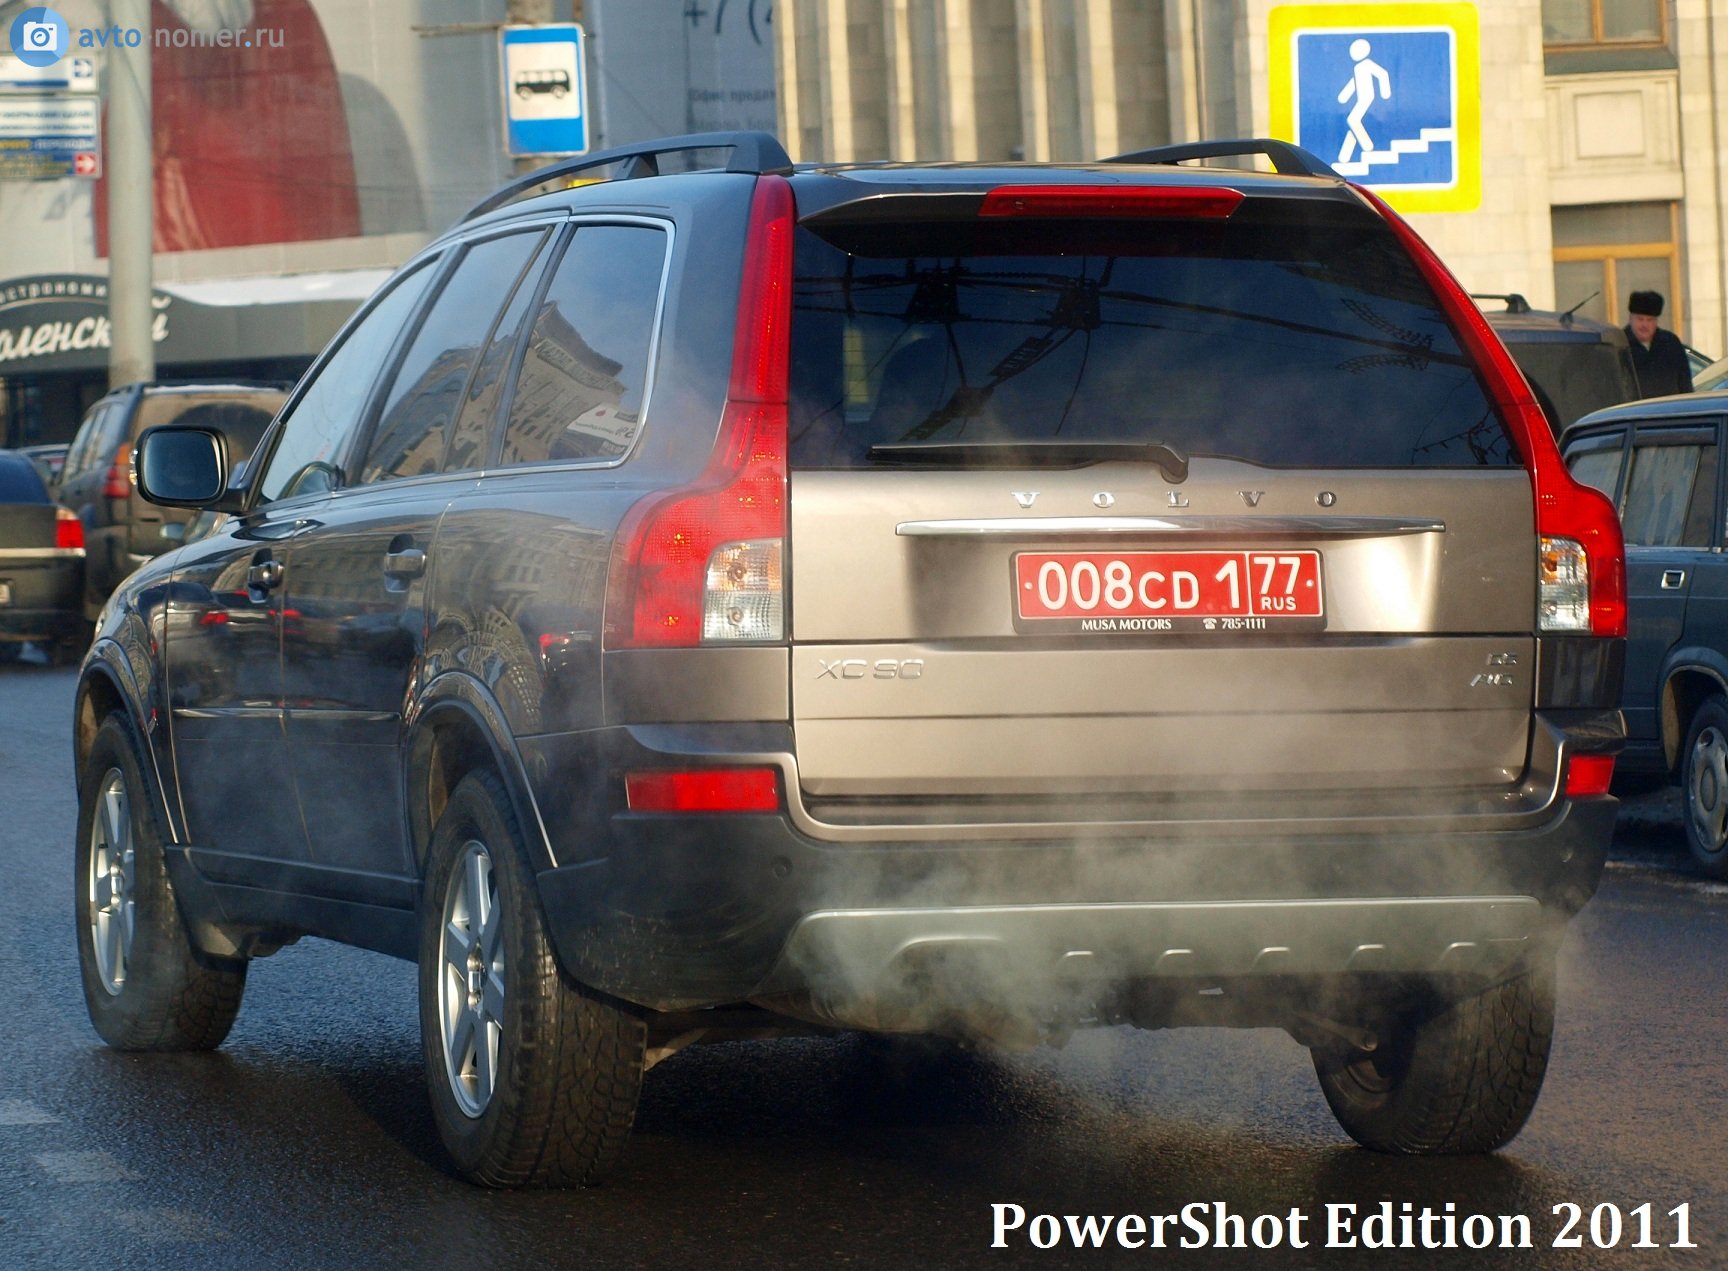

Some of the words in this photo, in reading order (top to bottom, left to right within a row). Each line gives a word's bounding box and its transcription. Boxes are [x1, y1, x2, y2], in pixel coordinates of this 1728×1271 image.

[1010, 491, 1338, 508] VOLVO
[1253, 556, 1301, 595] 77
[1260, 595, 1297, 611] RUS
[1081, 619, 1117, 631] MUSA
[1119, 618, 1172, 631] MOTORS
[1221, 617, 1266, 630] 785-1111
